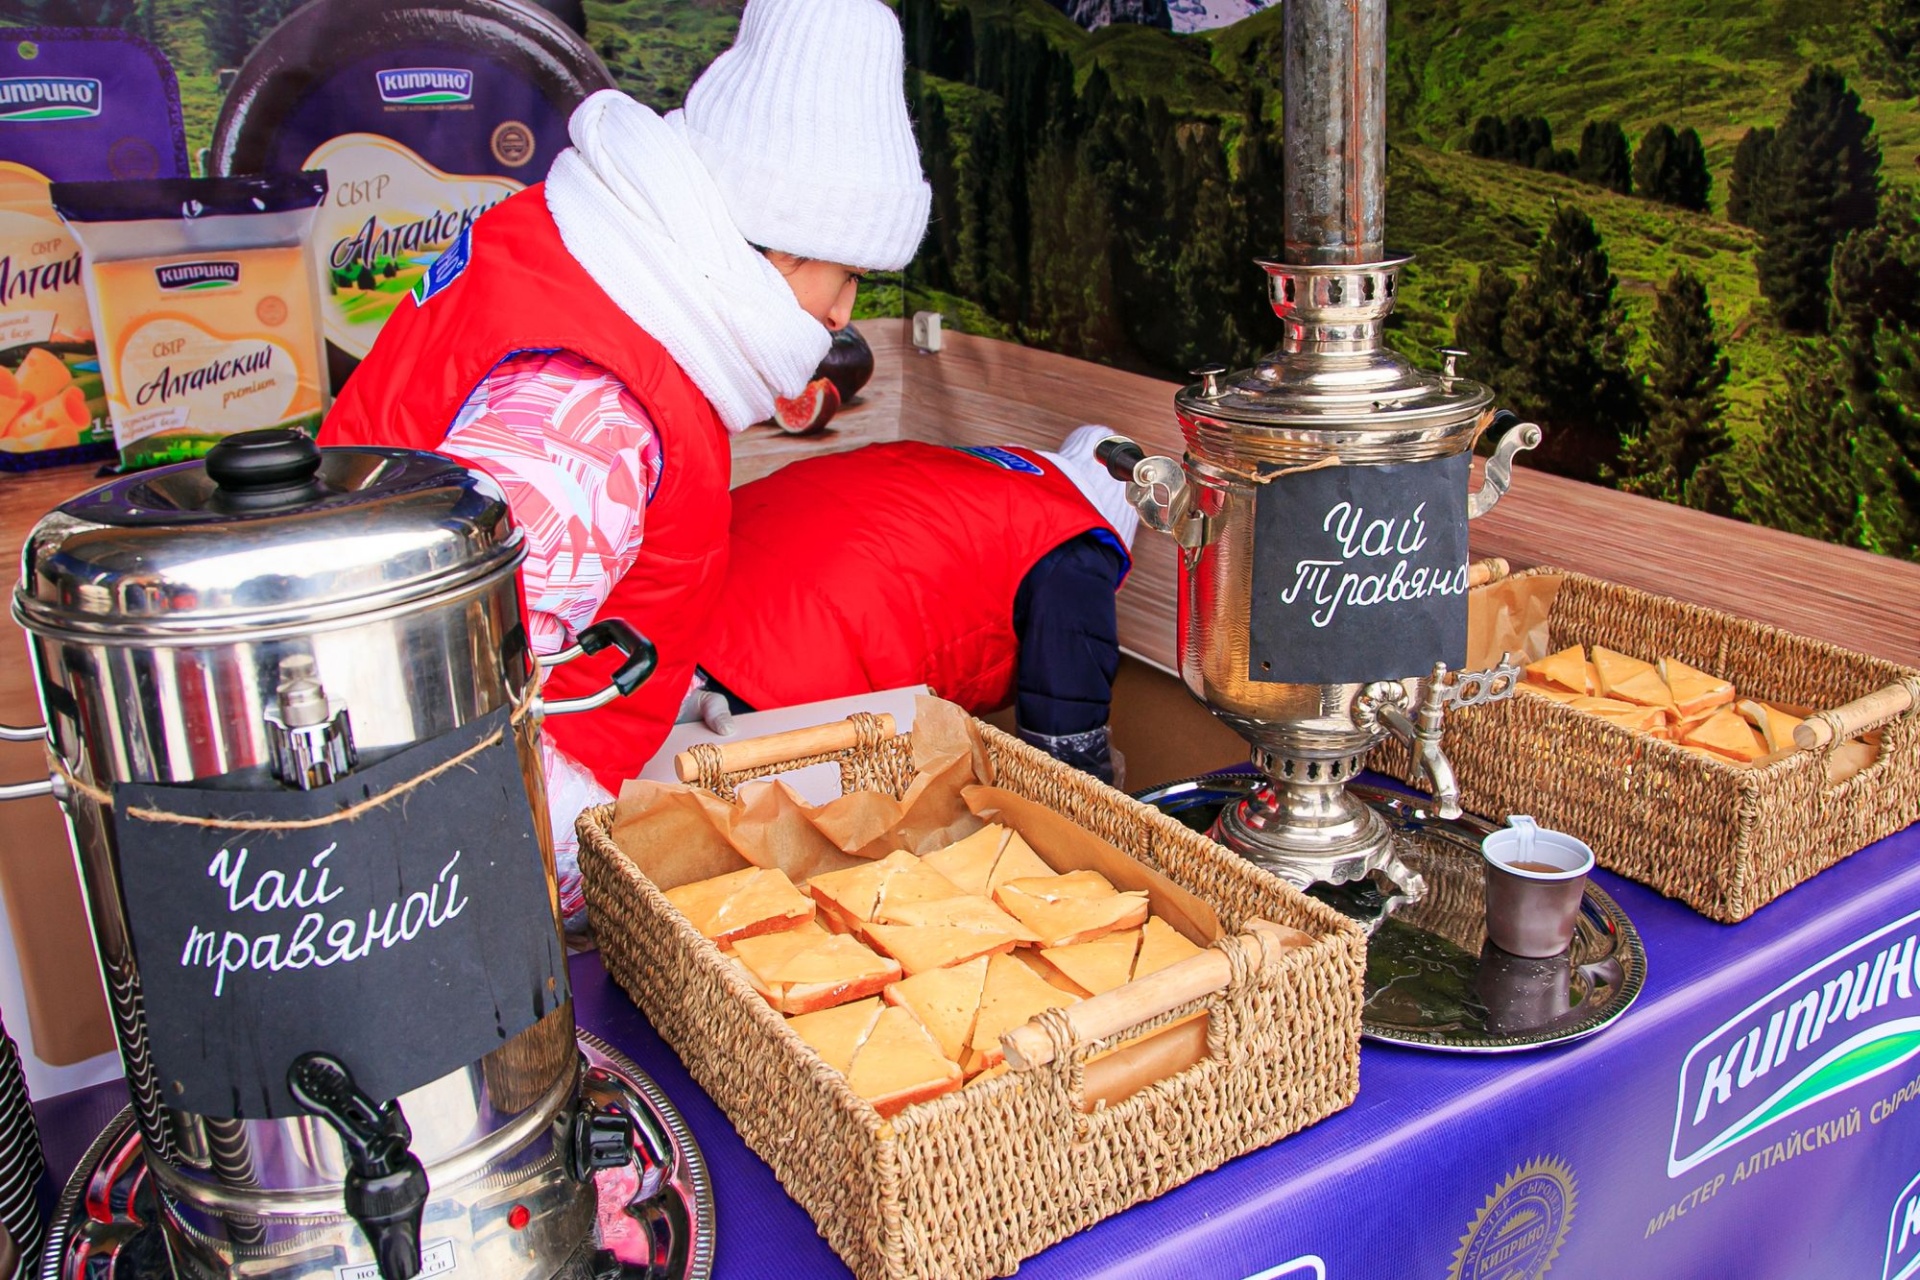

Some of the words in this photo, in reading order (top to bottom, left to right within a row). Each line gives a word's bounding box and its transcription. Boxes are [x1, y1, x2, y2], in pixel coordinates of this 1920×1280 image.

[330, 192, 512, 269] Алтайск
[136, 344, 273, 406] Алтайский
[223, 377, 277, 409] premium
[1323, 501, 1428, 559] Чай
[1281, 552, 1470, 628] Травяно
[208, 842, 345, 912] Чай
[180, 849, 470, 997] травяной
[1644, 1174, 1726, 1240] МАСТЕР
[1731, 1106, 1861, 1186] АЛТАЙСКИЙ
[1480, 1223, 1546, 1275] КИПРИНО
